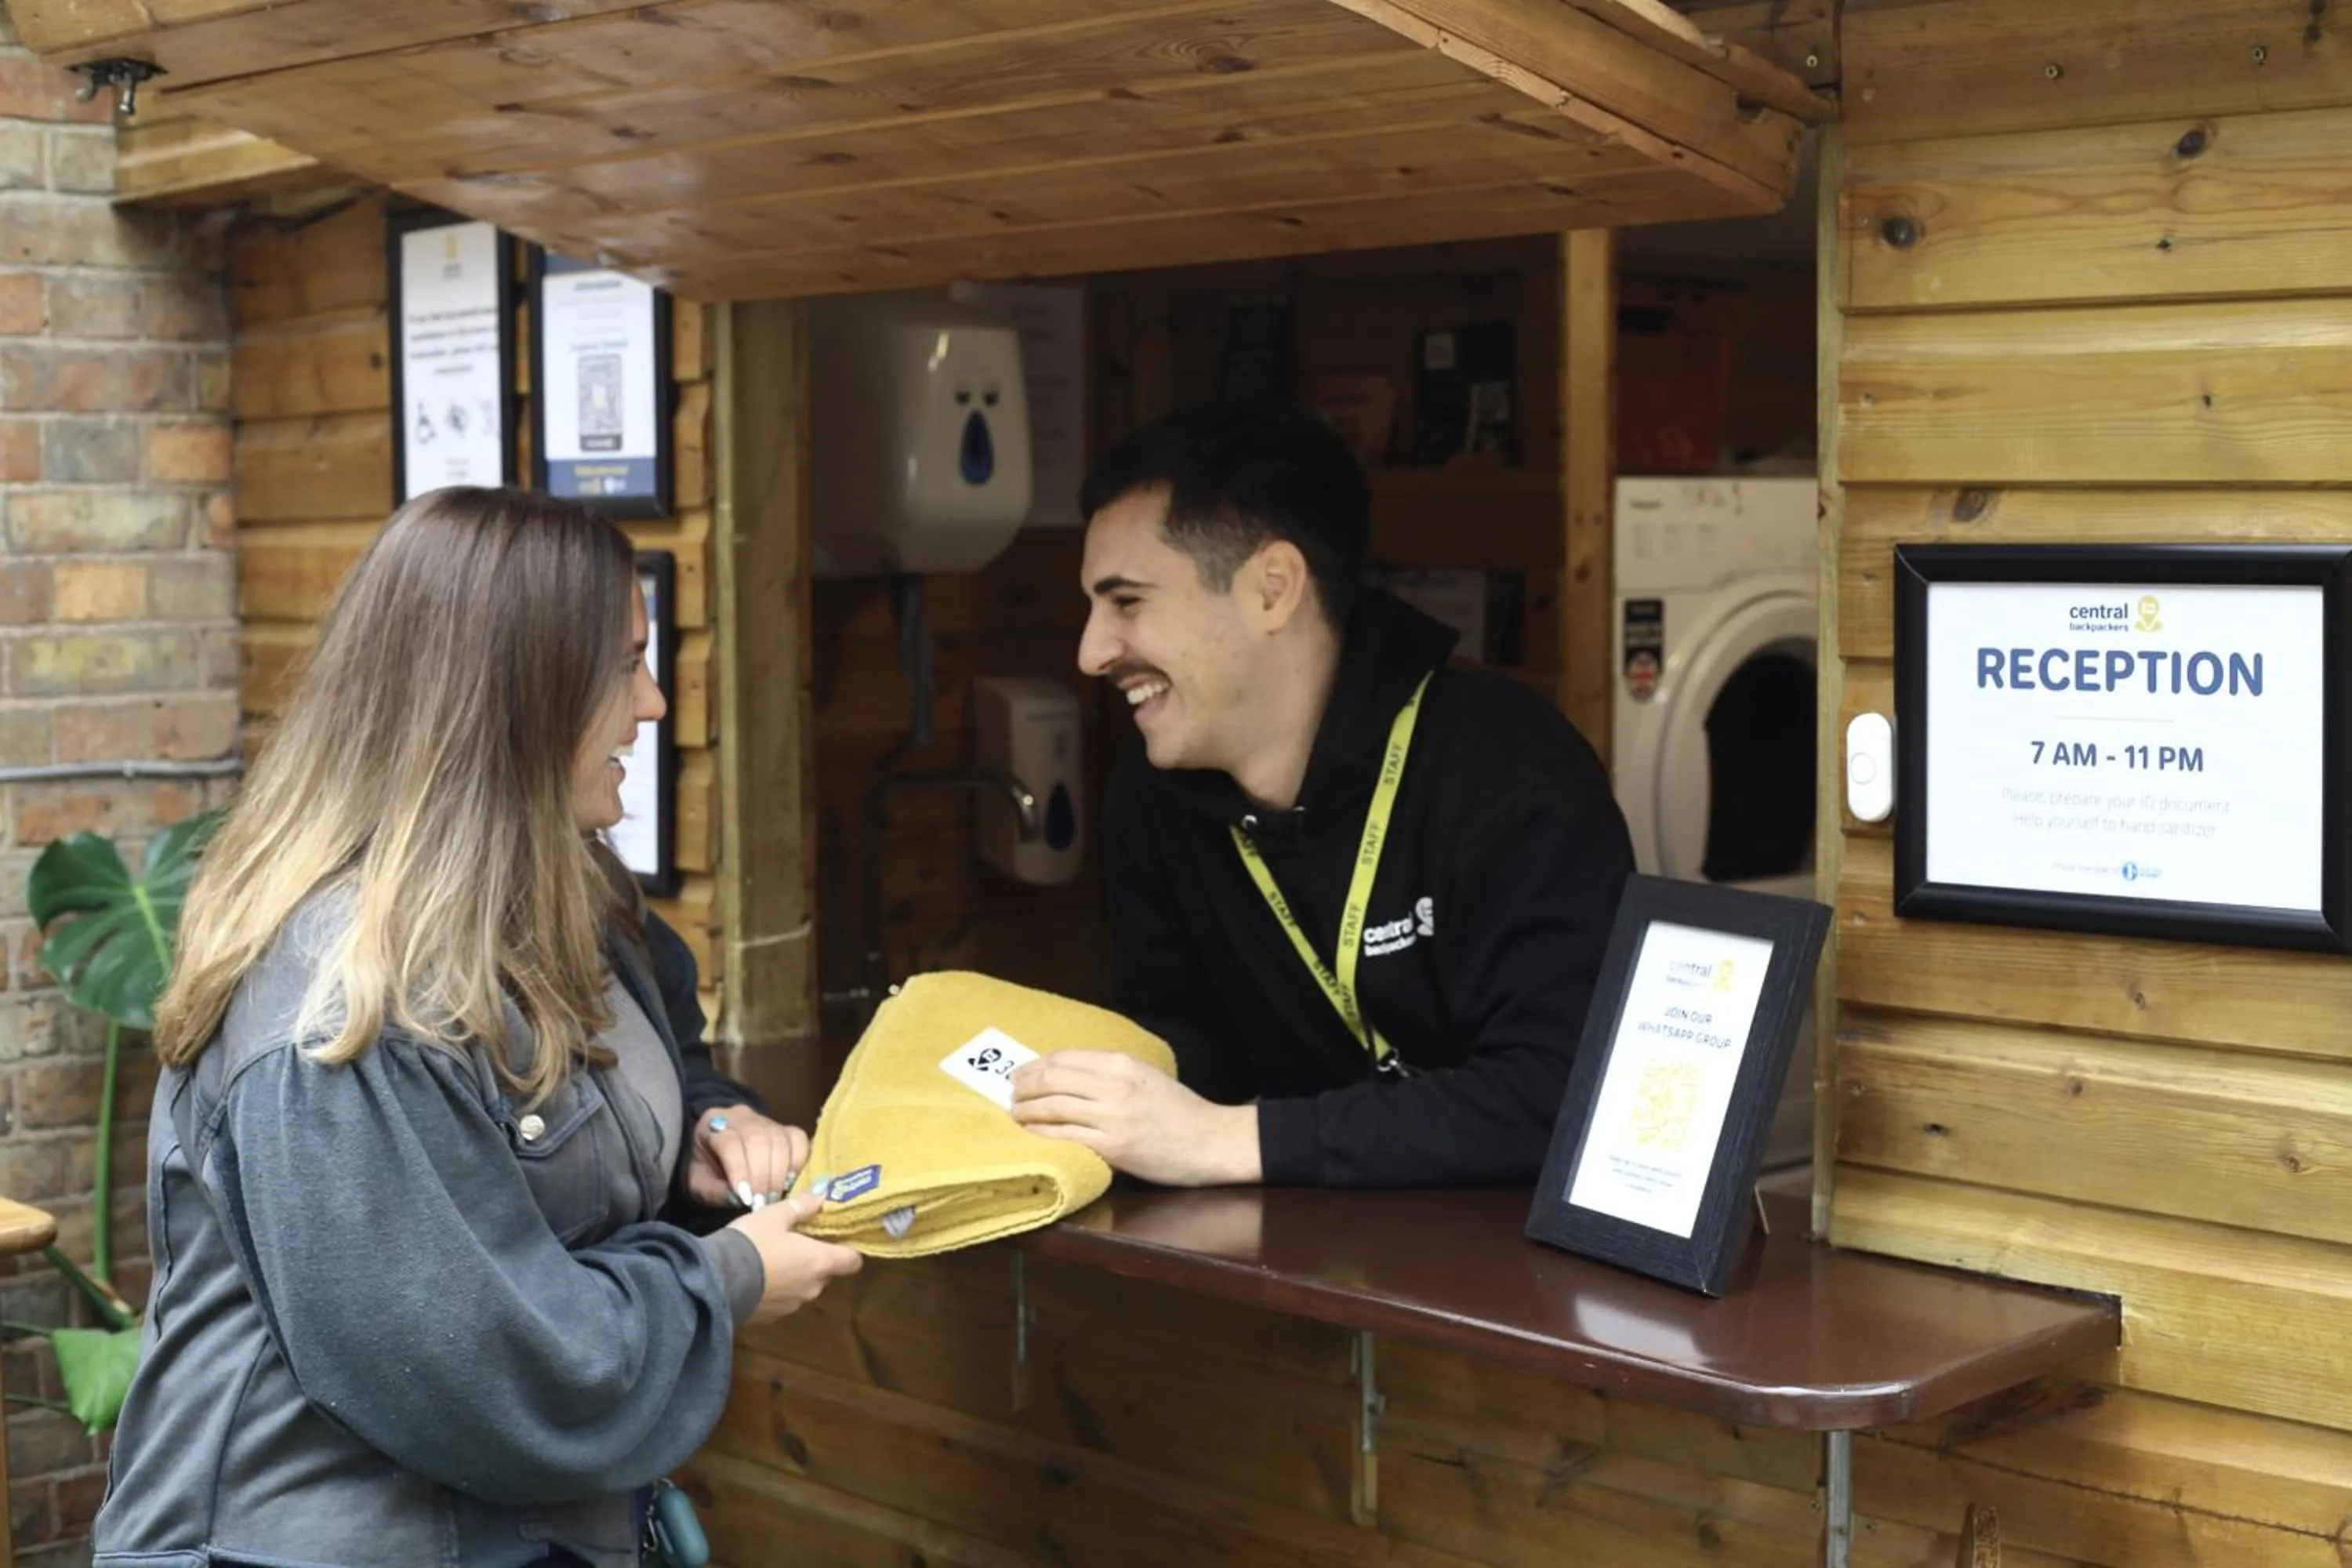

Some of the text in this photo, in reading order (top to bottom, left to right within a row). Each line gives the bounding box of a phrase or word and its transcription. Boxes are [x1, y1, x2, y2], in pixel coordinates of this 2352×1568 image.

[2069, 602, 2129, 619] central
[1976, 647, 2263, 697] RECEPTION
[1384, 741, 1406, 785] STAFF
[2031, 740, 2045, 764] 7
[2052, 741, 2097, 768] AM
[2124, 744, 2149, 770] 11
[2158, 746, 2203, 772] PM
[2107, 794, 2136, 811] your
[2159, 796, 2230, 815] document
[2103, 817, 2116, 832] to
[2121, 818, 2155, 834] hand
[1361, 820, 1380, 866] STAFF
[1268, 891, 1298, 928] STAFF
[1342, 902, 1362, 949] STAFF
[1313, 960, 1341, 995] STAFF
[1663, 1006, 1714, 1025] JOIN OUR
[1694, 1032, 1732, 1050] GROUP
